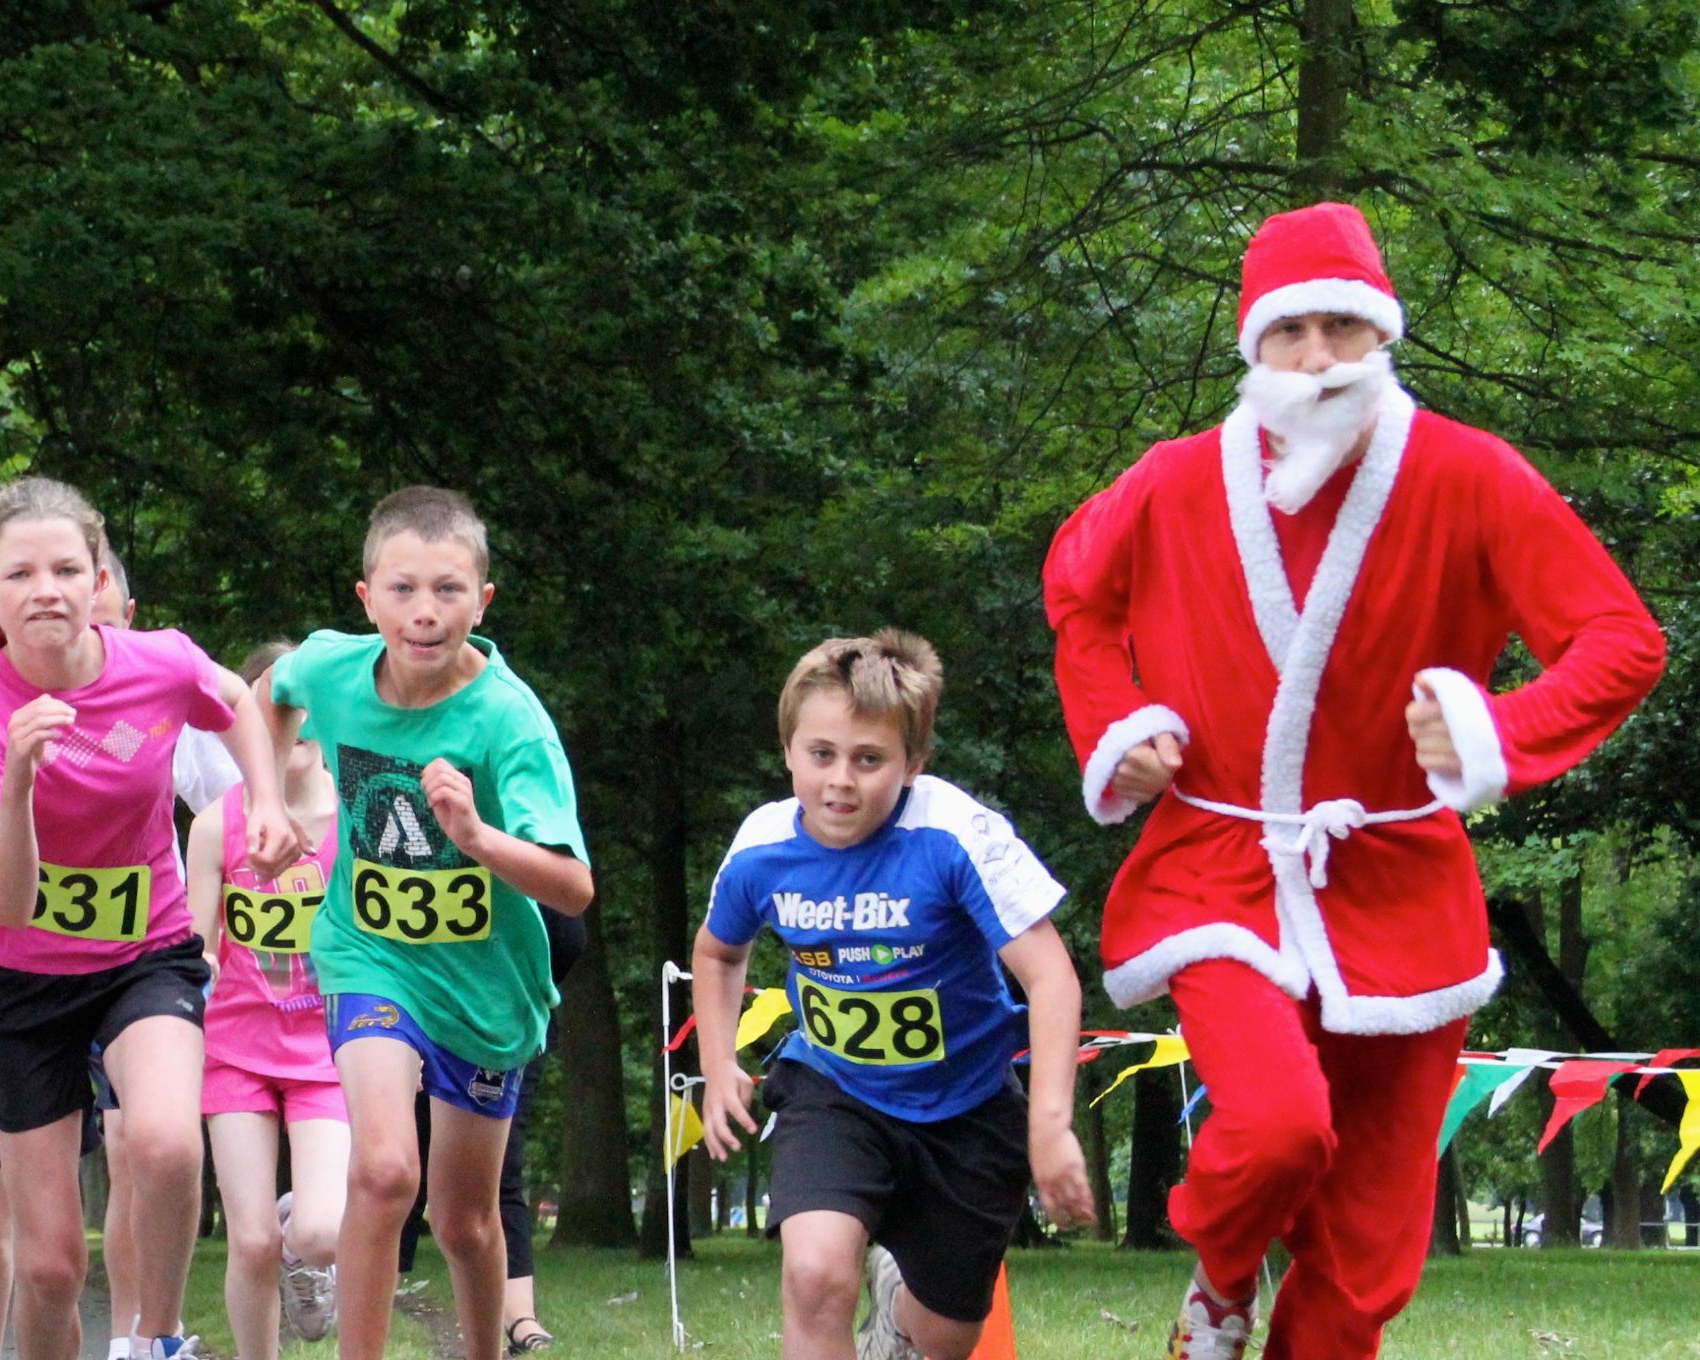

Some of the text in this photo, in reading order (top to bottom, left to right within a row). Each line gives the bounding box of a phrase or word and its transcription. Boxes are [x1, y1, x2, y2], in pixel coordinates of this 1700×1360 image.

[355, 869, 489, 939] 633
[772, 892, 911, 932] Weet-Bix
[837, 944, 925, 964] PUSH PLAY
[816, 971, 855, 985] TOYOTA
[802, 985, 940, 1060] 628
